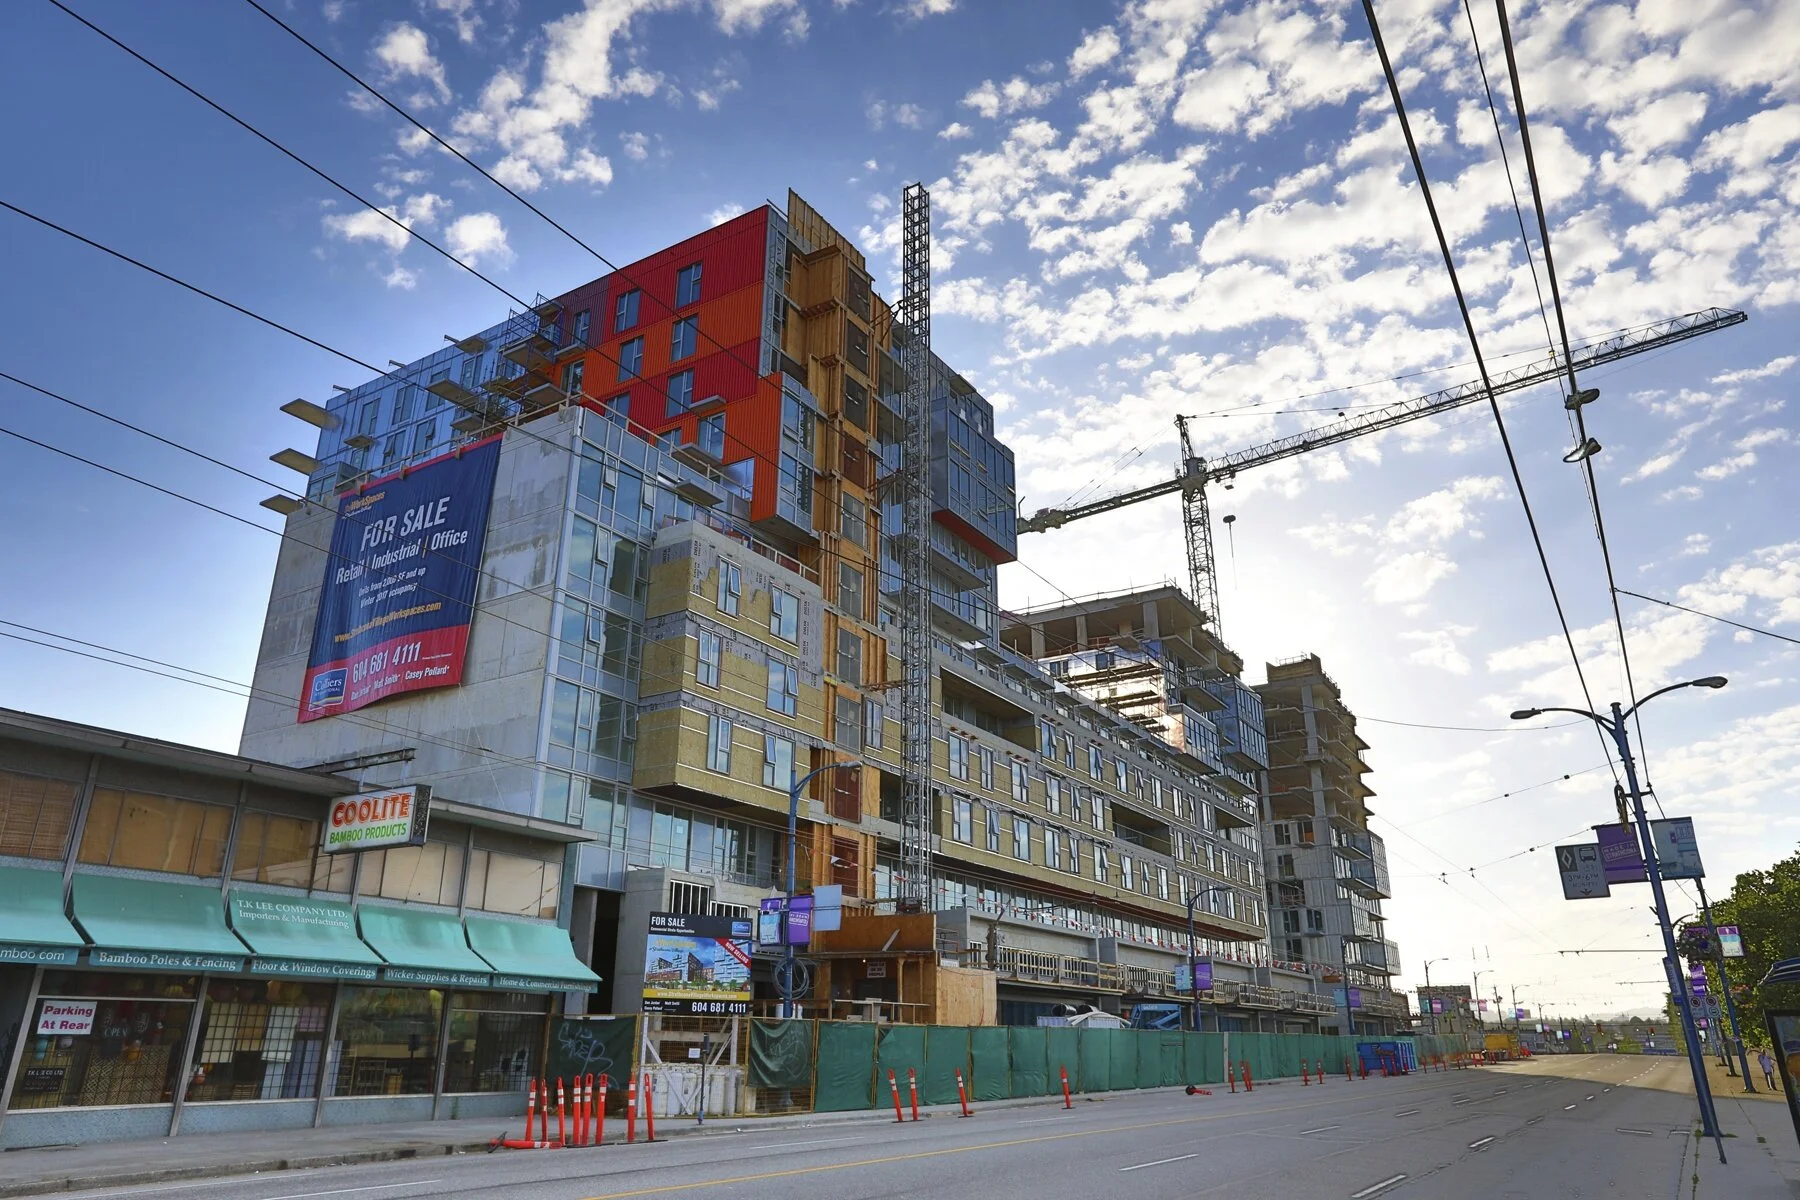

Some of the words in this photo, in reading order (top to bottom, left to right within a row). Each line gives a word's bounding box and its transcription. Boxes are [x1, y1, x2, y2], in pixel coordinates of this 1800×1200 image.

[361, 515, 398, 552] FOR
[400, 496, 450, 537] SALE
[336, 559, 365, 585] Retail
[371, 538, 422, 571] Industrial
[431, 529, 468, 551] Office
[370, 582, 382, 591] from
[398, 571, 406, 582] SF
[406, 567, 417, 578] and
[417, 567, 426, 577] up
[360, 596, 376, 608] Winter
[352, 659, 368, 683] 604
[369, 650, 390, 675] 681
[392, 641, 422, 666] 4111
[405, 670, 423, 681] Casey
[314, 678, 342, 692] Colliers
[332, 792, 411, 827] COOLITE
[329, 829, 362, 844] BAMBOO
[364, 823, 407, 840] PRODUCTS
[256, 901, 273, 910] LEE
[275, 904, 325, 916] COMPANY
[239, 910, 280, 921] Importers
[281, 914, 290, 922] &
[291, 915, 349, 929] Manufacturing
[651, 916, 666, 926] FOR
[667, 917, 686, 928] SALE
[99, 951, 147, 964] Bamboo
[150, 955, 180, 967] Poles
[182, 957, 192, 967] &
[195, 957, 237, 971] Fencing
[253, 960, 278, 971] Floor
[280, 962, 289, 972] &
[291, 962, 331, 974] Window
[332, 965, 376, 979] Coverings
[386, 968, 415, 980] Wicker
[416, 971, 450, 984] Supplies
[450, 974, 458, 983] &
[459, 974, 487, 985] Repairs
[500, 976, 518, 986] Home
[43, 1005, 94, 1018] Parking
[691, 1002, 708, 1013] 604
[710, 1002, 725, 1013] 681
[728, 1003, 746, 1013] 4111
[40, 1020, 56, 1030] At
[58, 1020, 90, 1030] Rear
